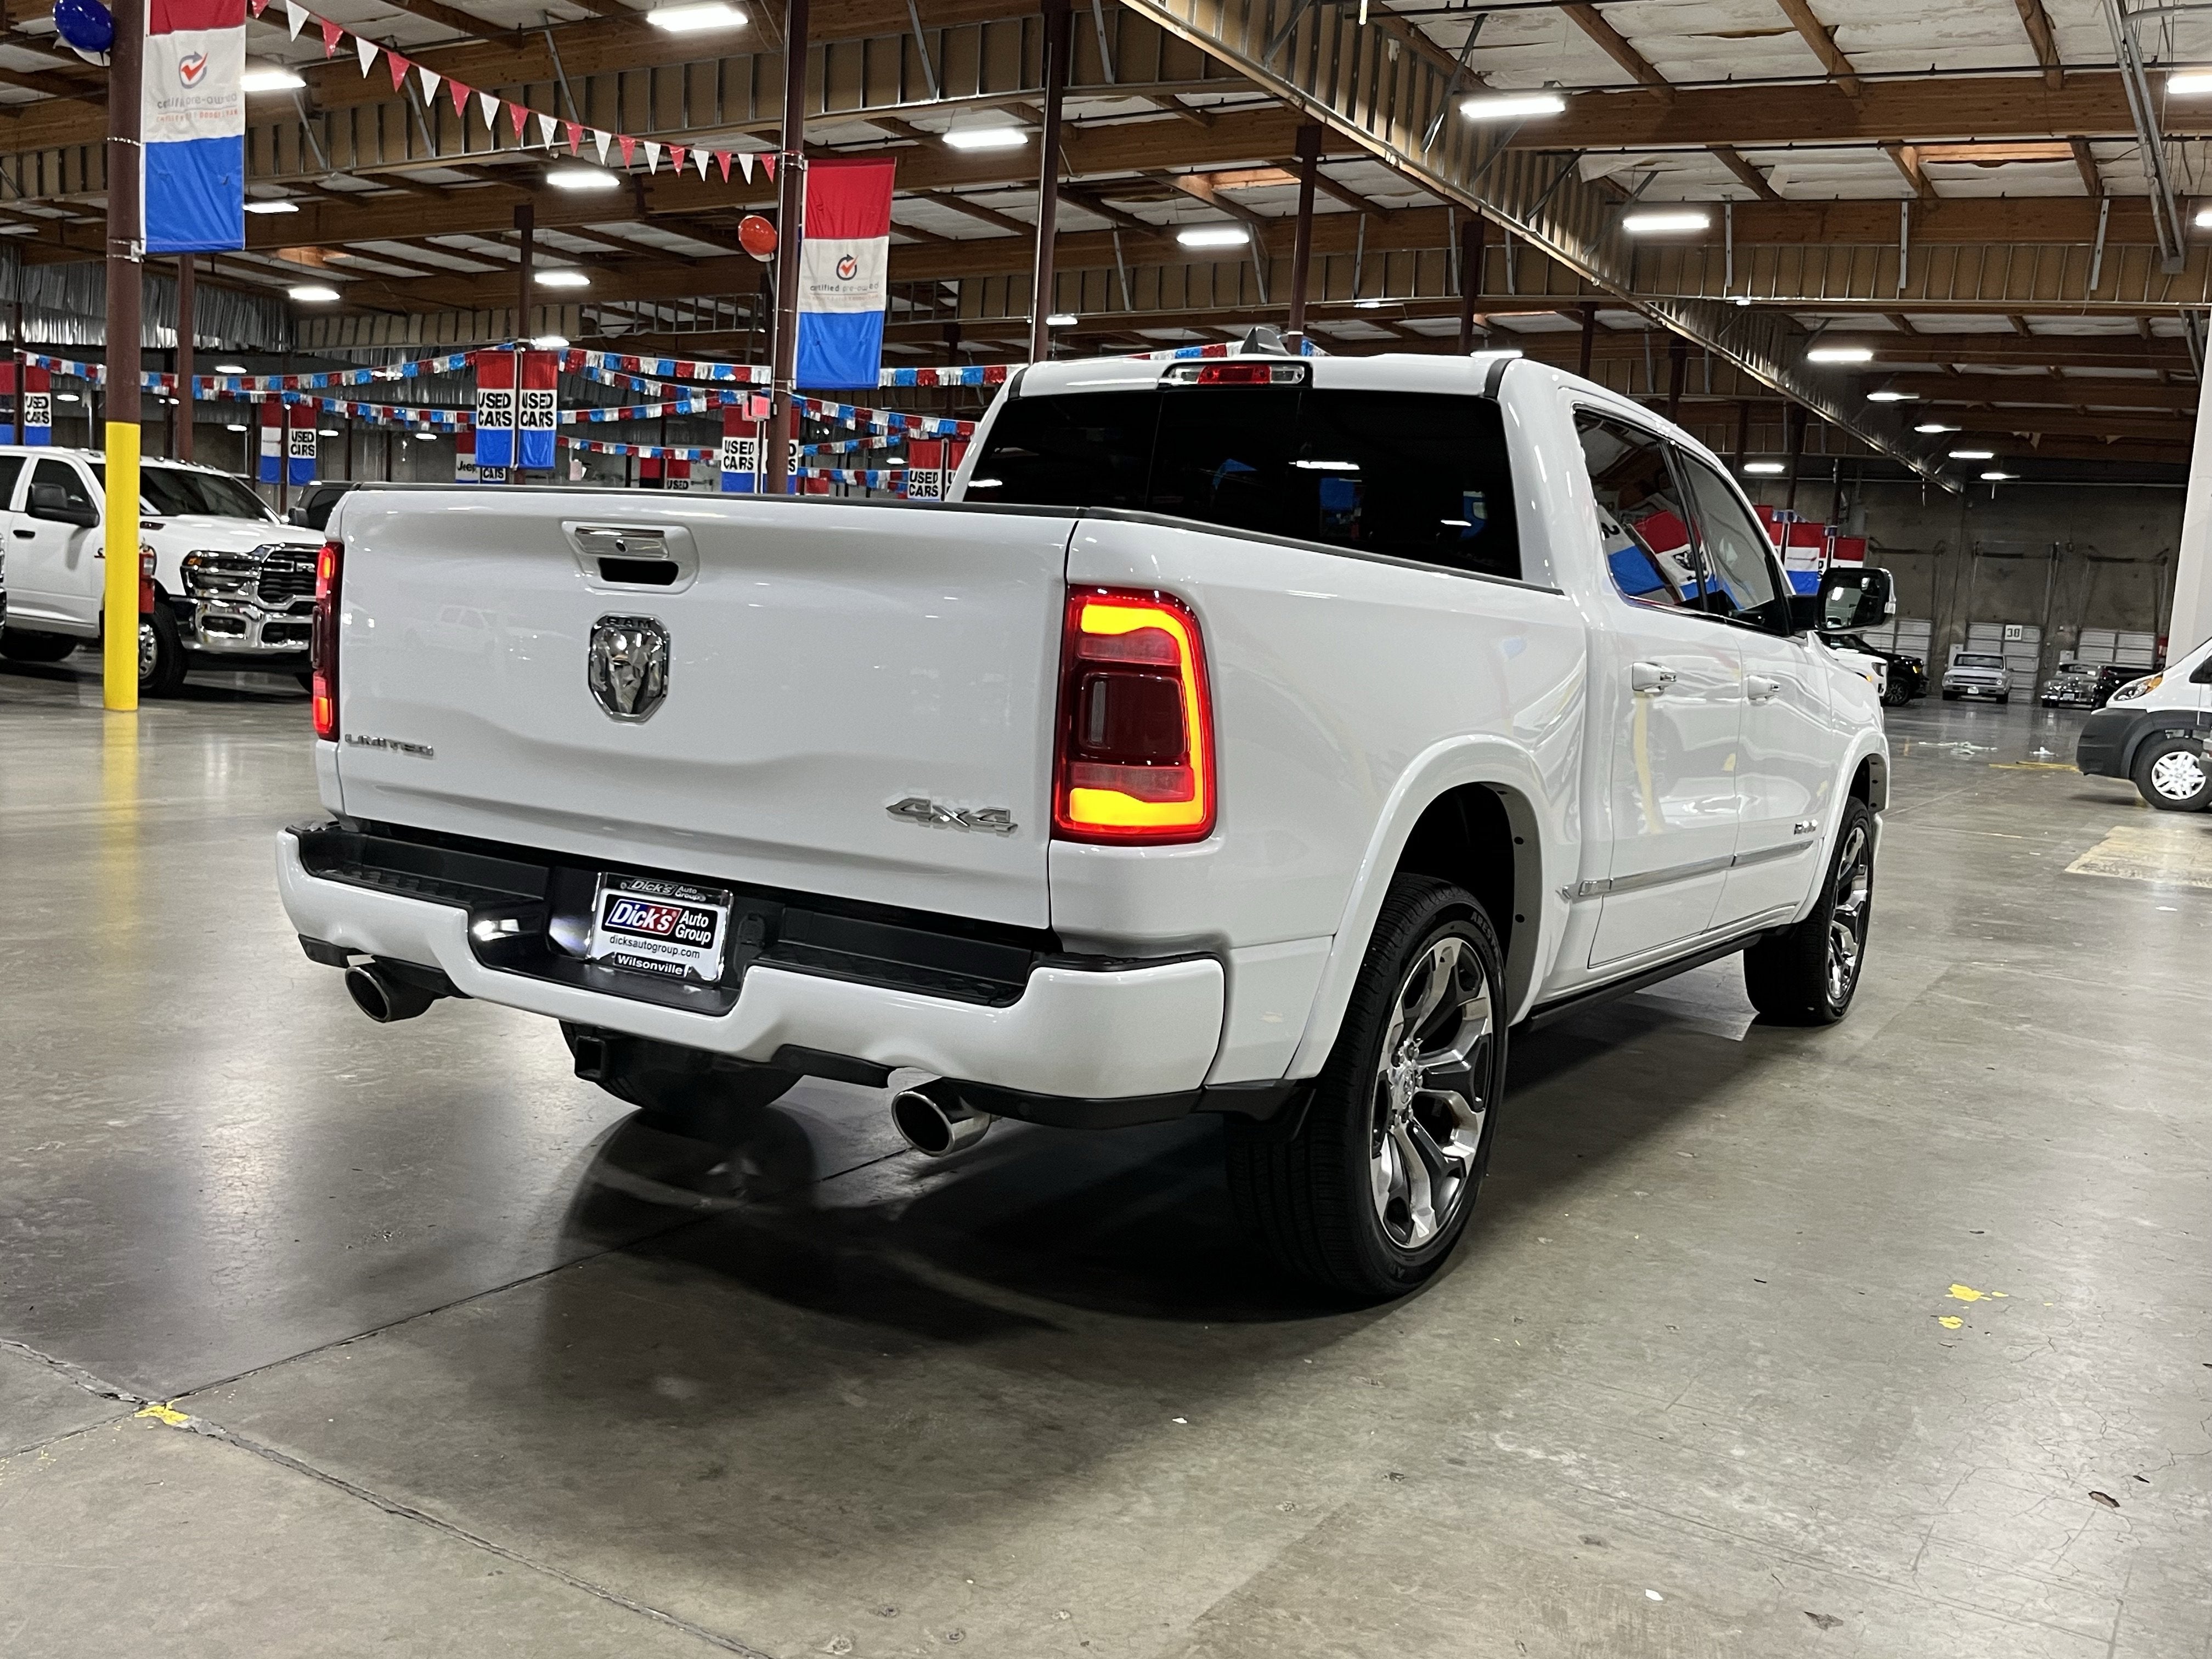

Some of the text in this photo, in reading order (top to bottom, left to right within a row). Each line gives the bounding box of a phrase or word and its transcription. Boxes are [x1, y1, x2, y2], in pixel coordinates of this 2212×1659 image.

[478, 392, 511, 409] USED
[522, 392, 553, 409] USED
[478, 410, 512, 427] CARS
[521, 410, 554, 427] CARS
[291, 430, 314, 443] USED
[725, 439, 754, 455] USED
[723, 455, 754, 471] CARS
[667, 479, 689, 490] USED
[909, 470, 939, 484] USED
[909, 483, 939, 497] CARS
[606, 617, 651, 628] RAM
[2006, 628, 2020, 637] 38
[345, 733, 434, 757] LIMITED
[631, 879, 674, 895] Dick's
[676, 885, 697, 894] Auto
[675, 890, 701, 901] Group
[611, 902, 673, 931] Dick's
[679, 910, 709, 928] Auto
[675, 924, 712, 945] Group
[610, 935, 700, 959] dicksautogroup.com
[617, 954, 684, 975] Wilsonville
